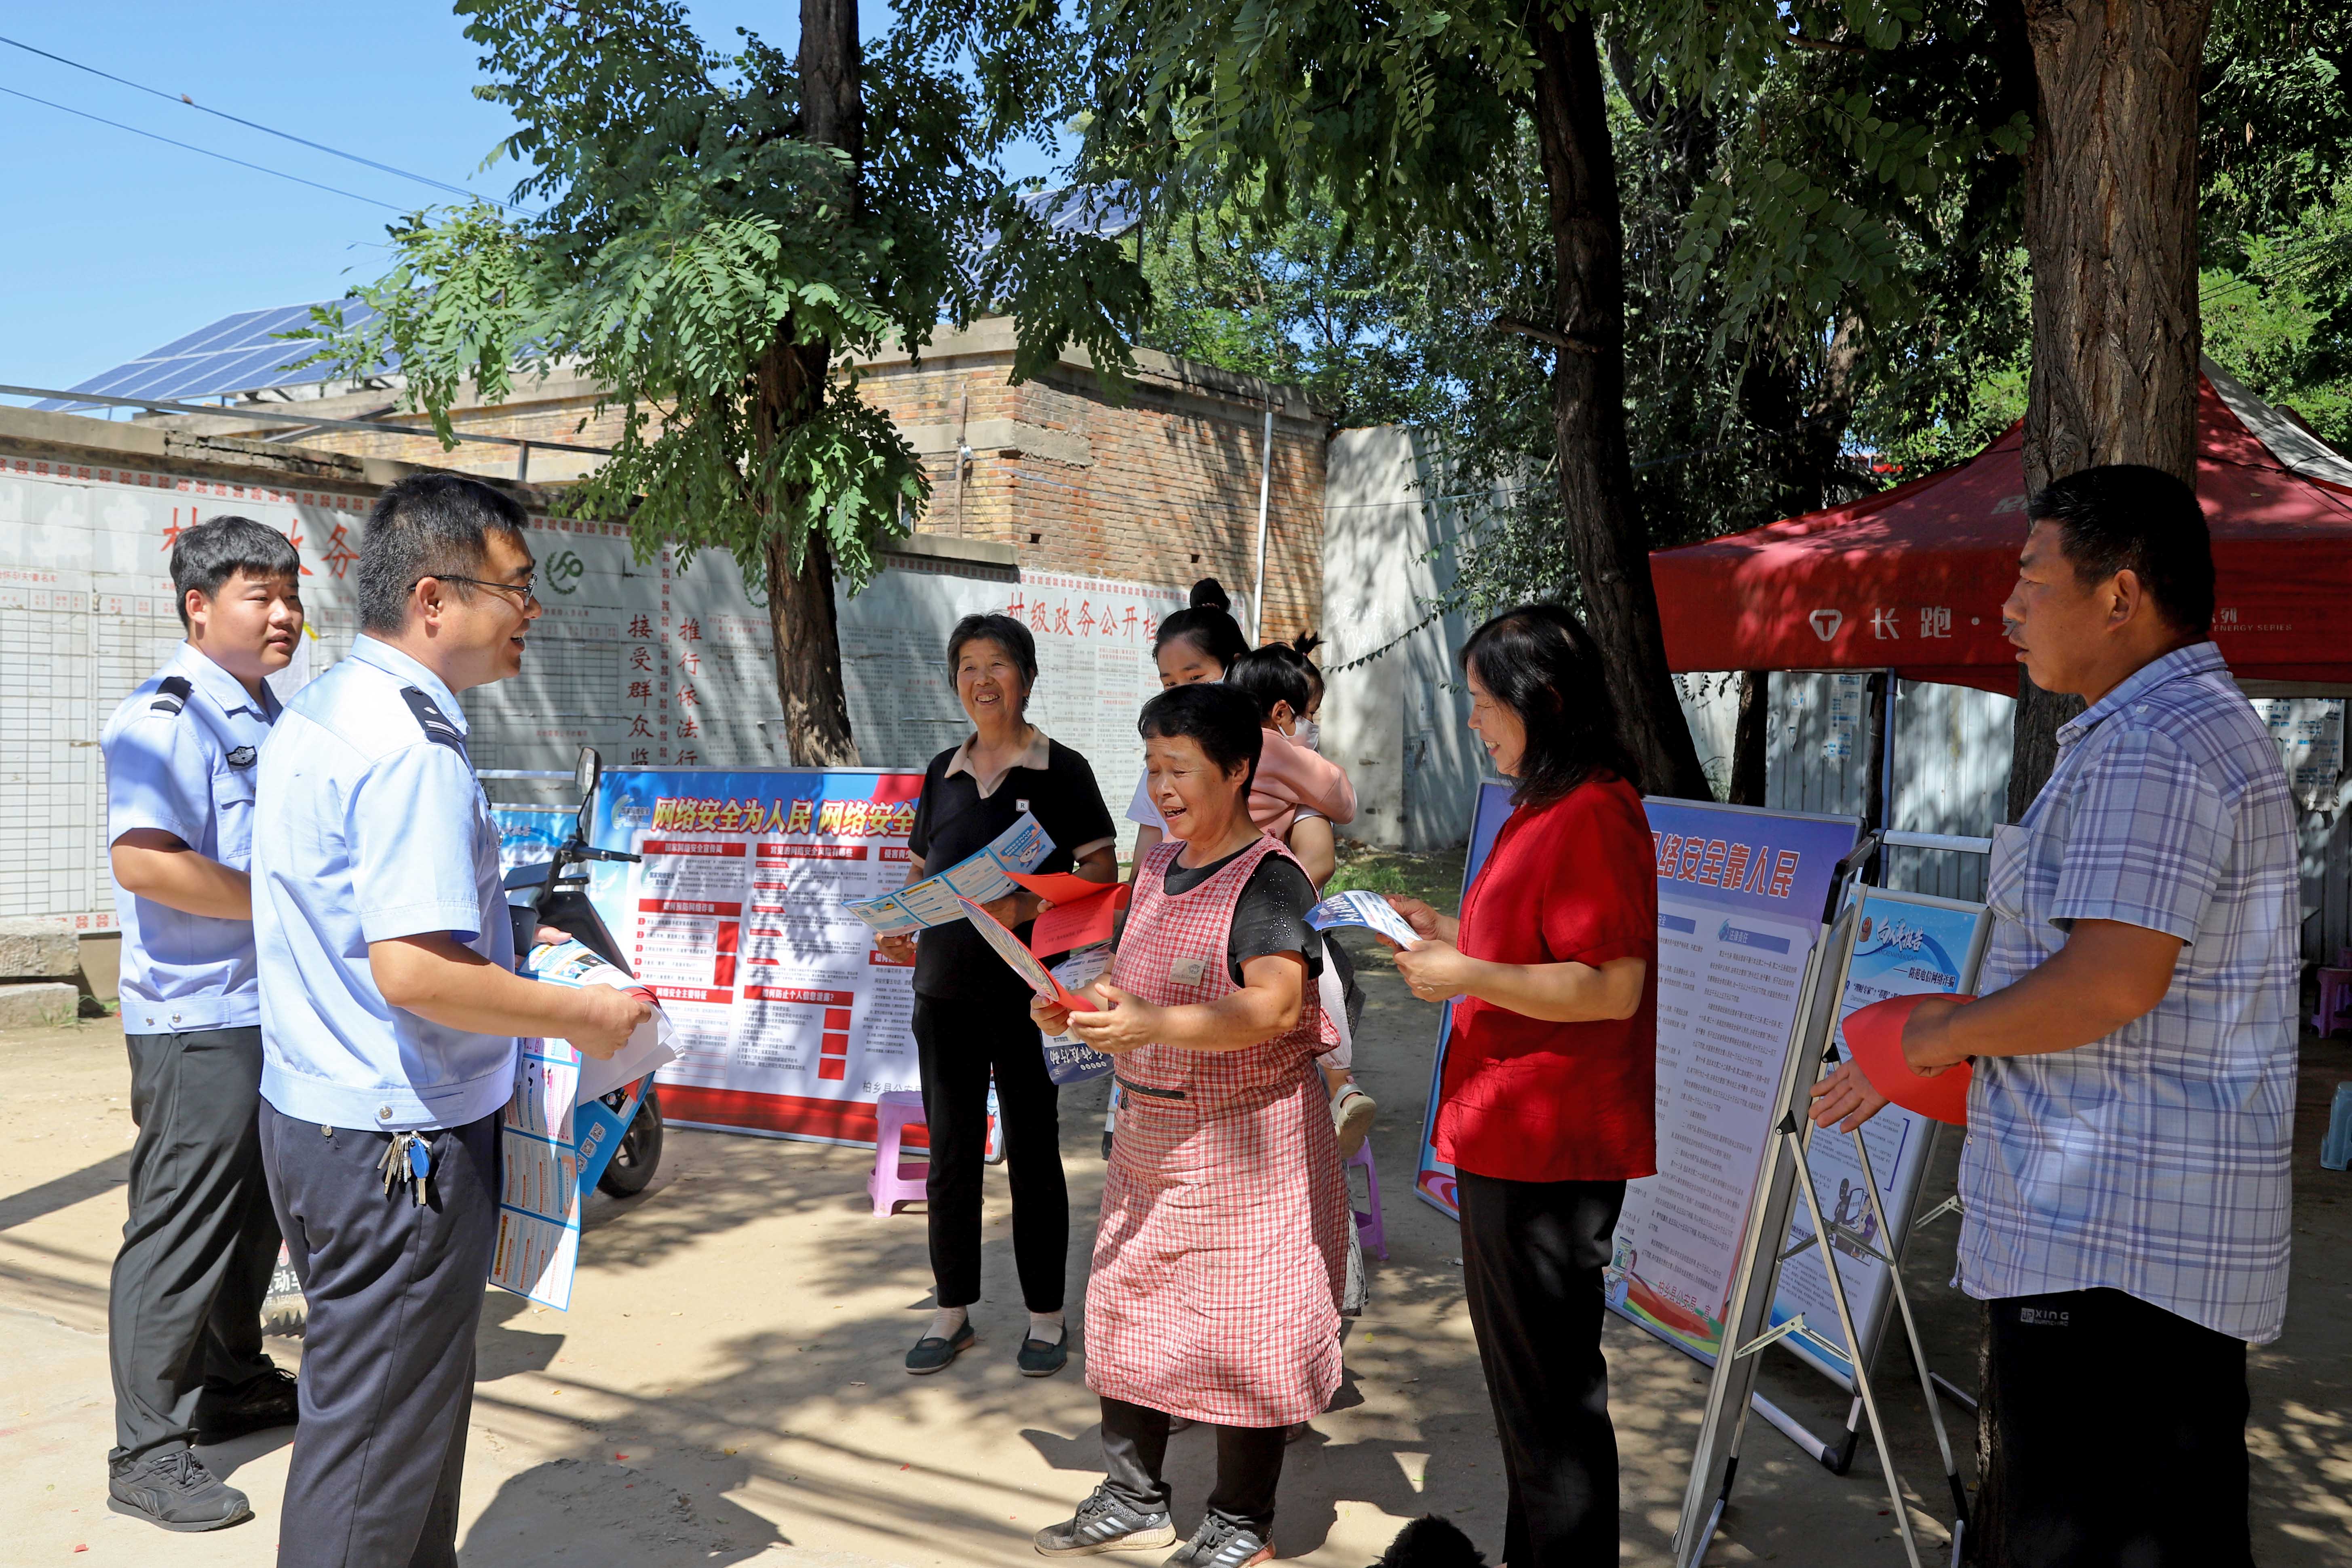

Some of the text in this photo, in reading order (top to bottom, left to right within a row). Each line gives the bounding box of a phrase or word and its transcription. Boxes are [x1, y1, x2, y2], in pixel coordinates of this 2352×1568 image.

[651, 796, 813, 834] 网络安全为人民
[770, 845, 853, 857] 常见的网络安全风险有哪些
[1729, 929, 1749, 944] 法律责任
[656, 987, 707, 1000] 网络安全主要特征
